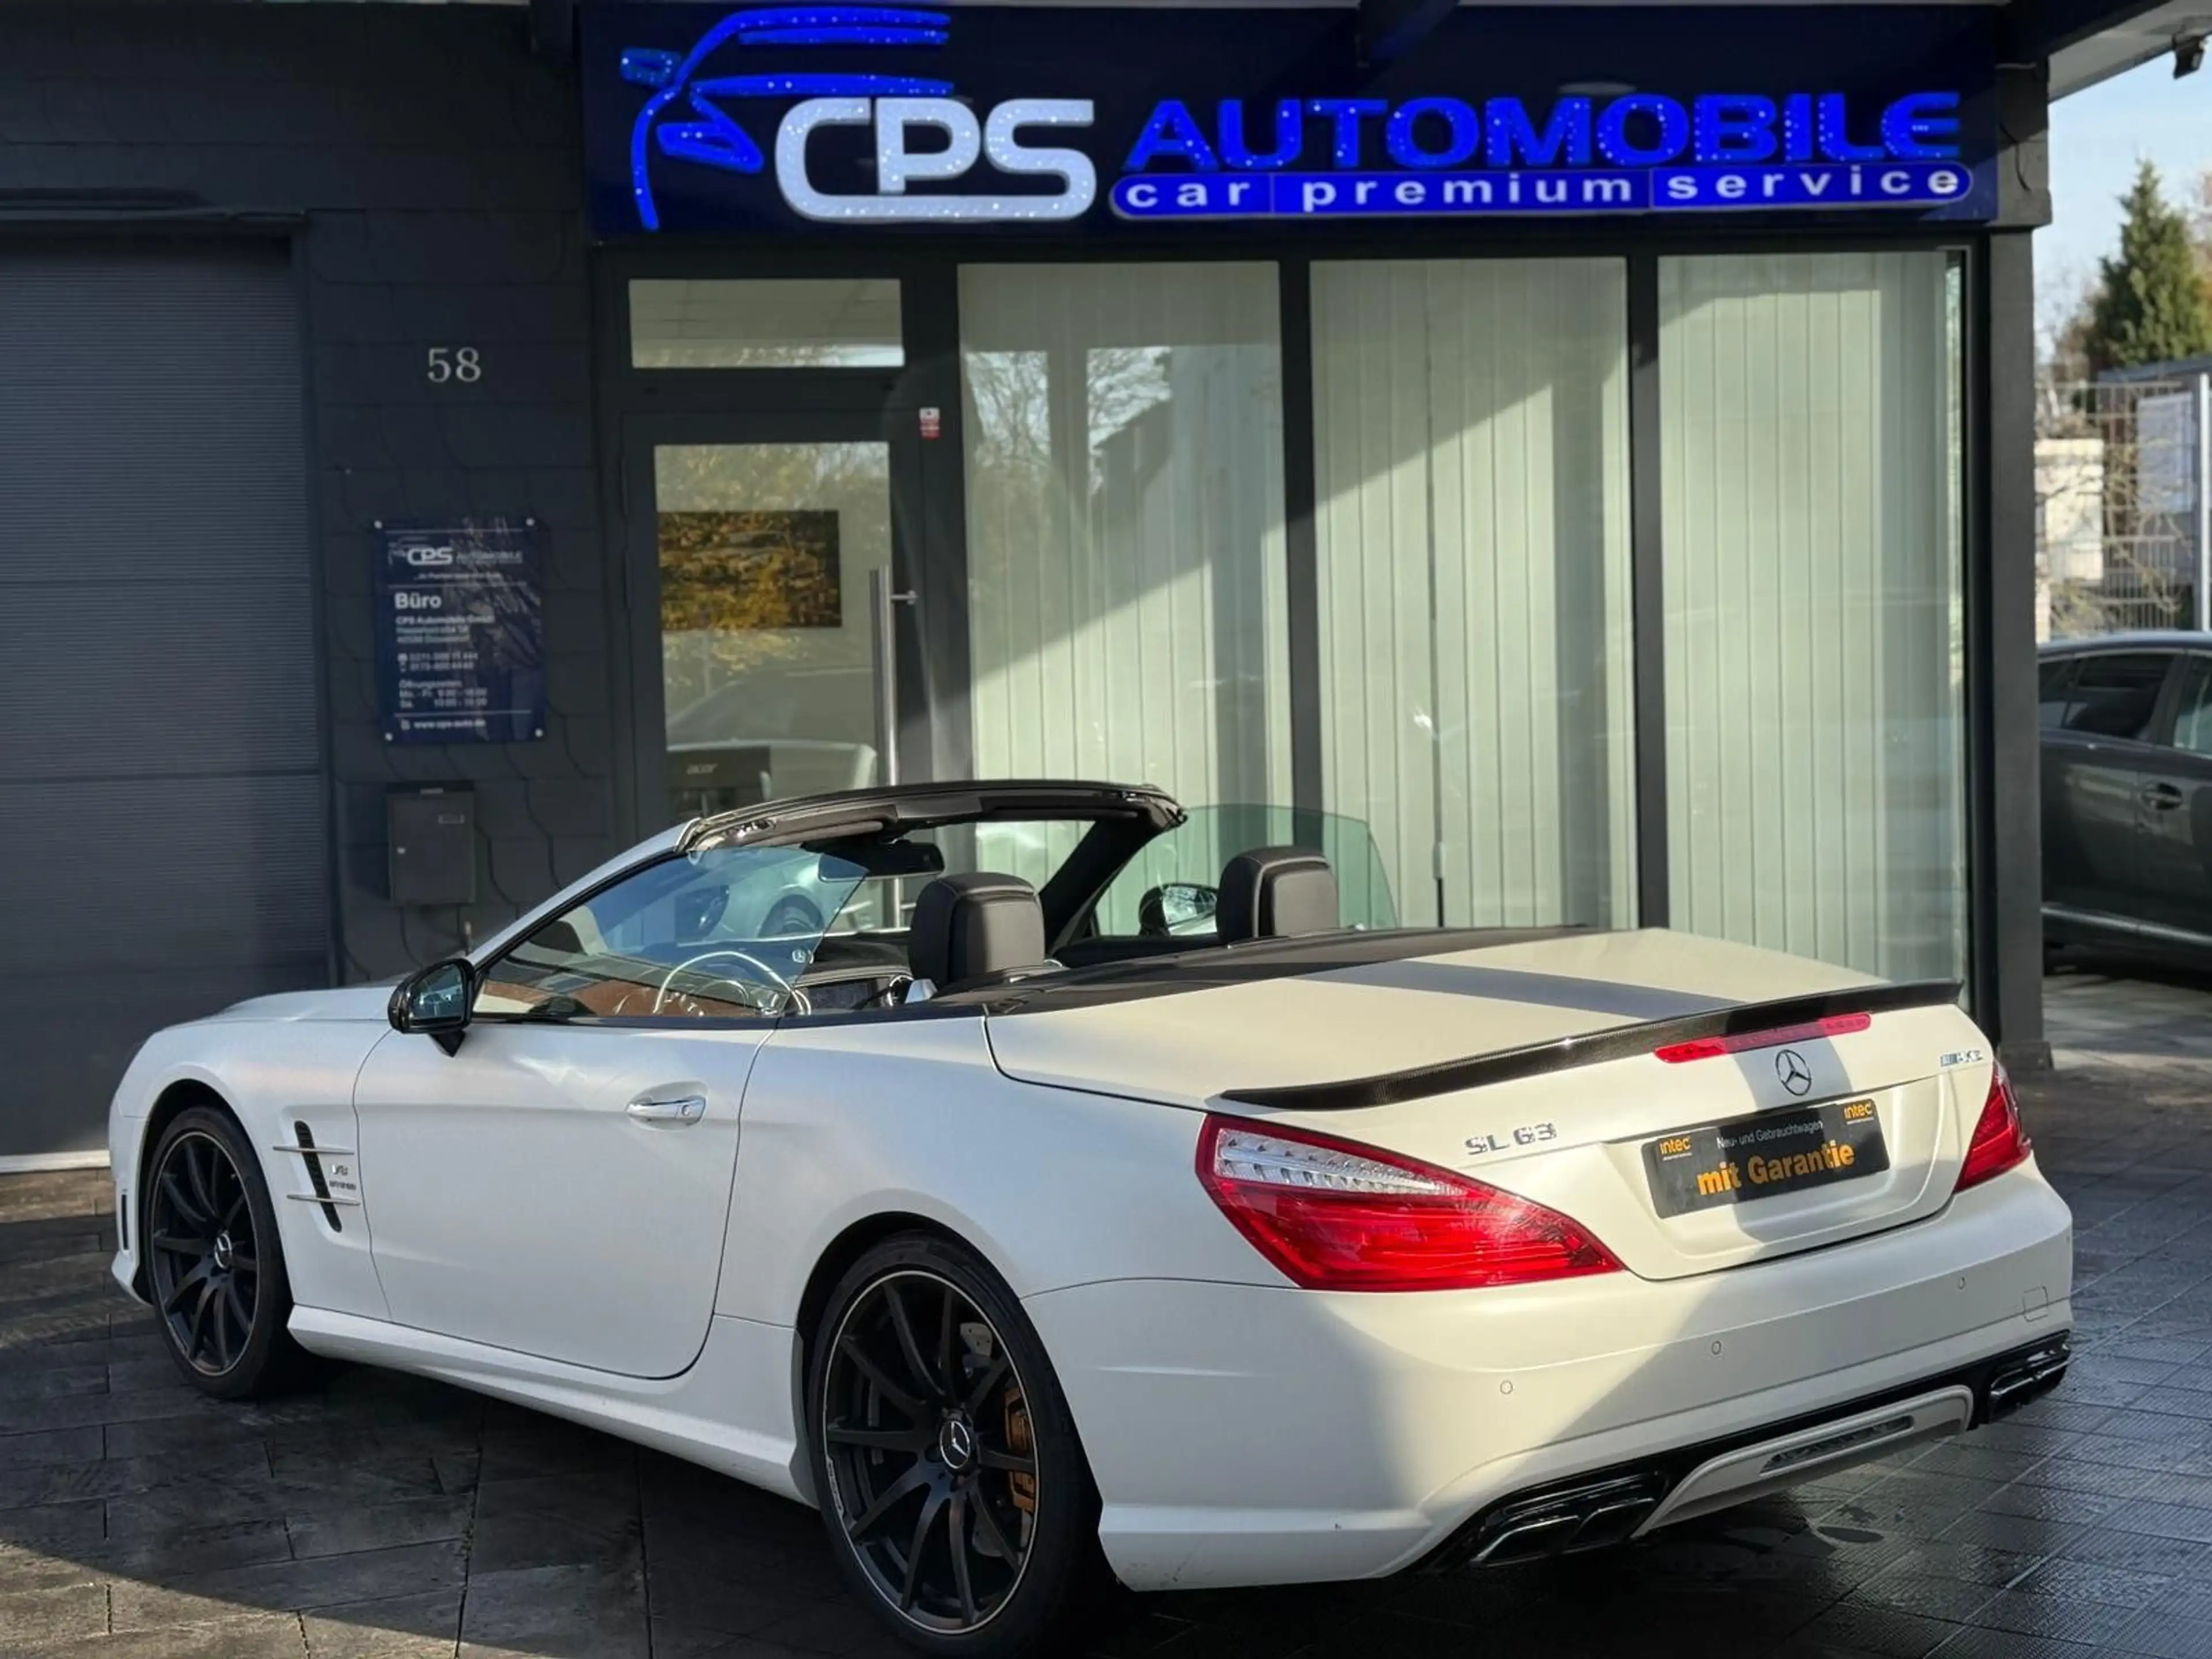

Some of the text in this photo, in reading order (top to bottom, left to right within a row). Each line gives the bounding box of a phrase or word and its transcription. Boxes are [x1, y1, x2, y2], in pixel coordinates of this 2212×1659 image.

[775, 91, 1960, 224] CPS AUTOMOBILE
[1126, 165, 1959, 213] car premium service
[427, 347, 482, 382] 58
[407, 547, 453, 566] CPS
[395, 592, 442, 609] Büro
[1844, 1102, 1873, 1119] intec
[1465, 1122, 1558, 1156] SL 63
[1659, 1137, 1692, 1154] intec
[1738, 1133, 1755, 1145] und
[1696, 1139, 1855, 1196] mit Garantie
